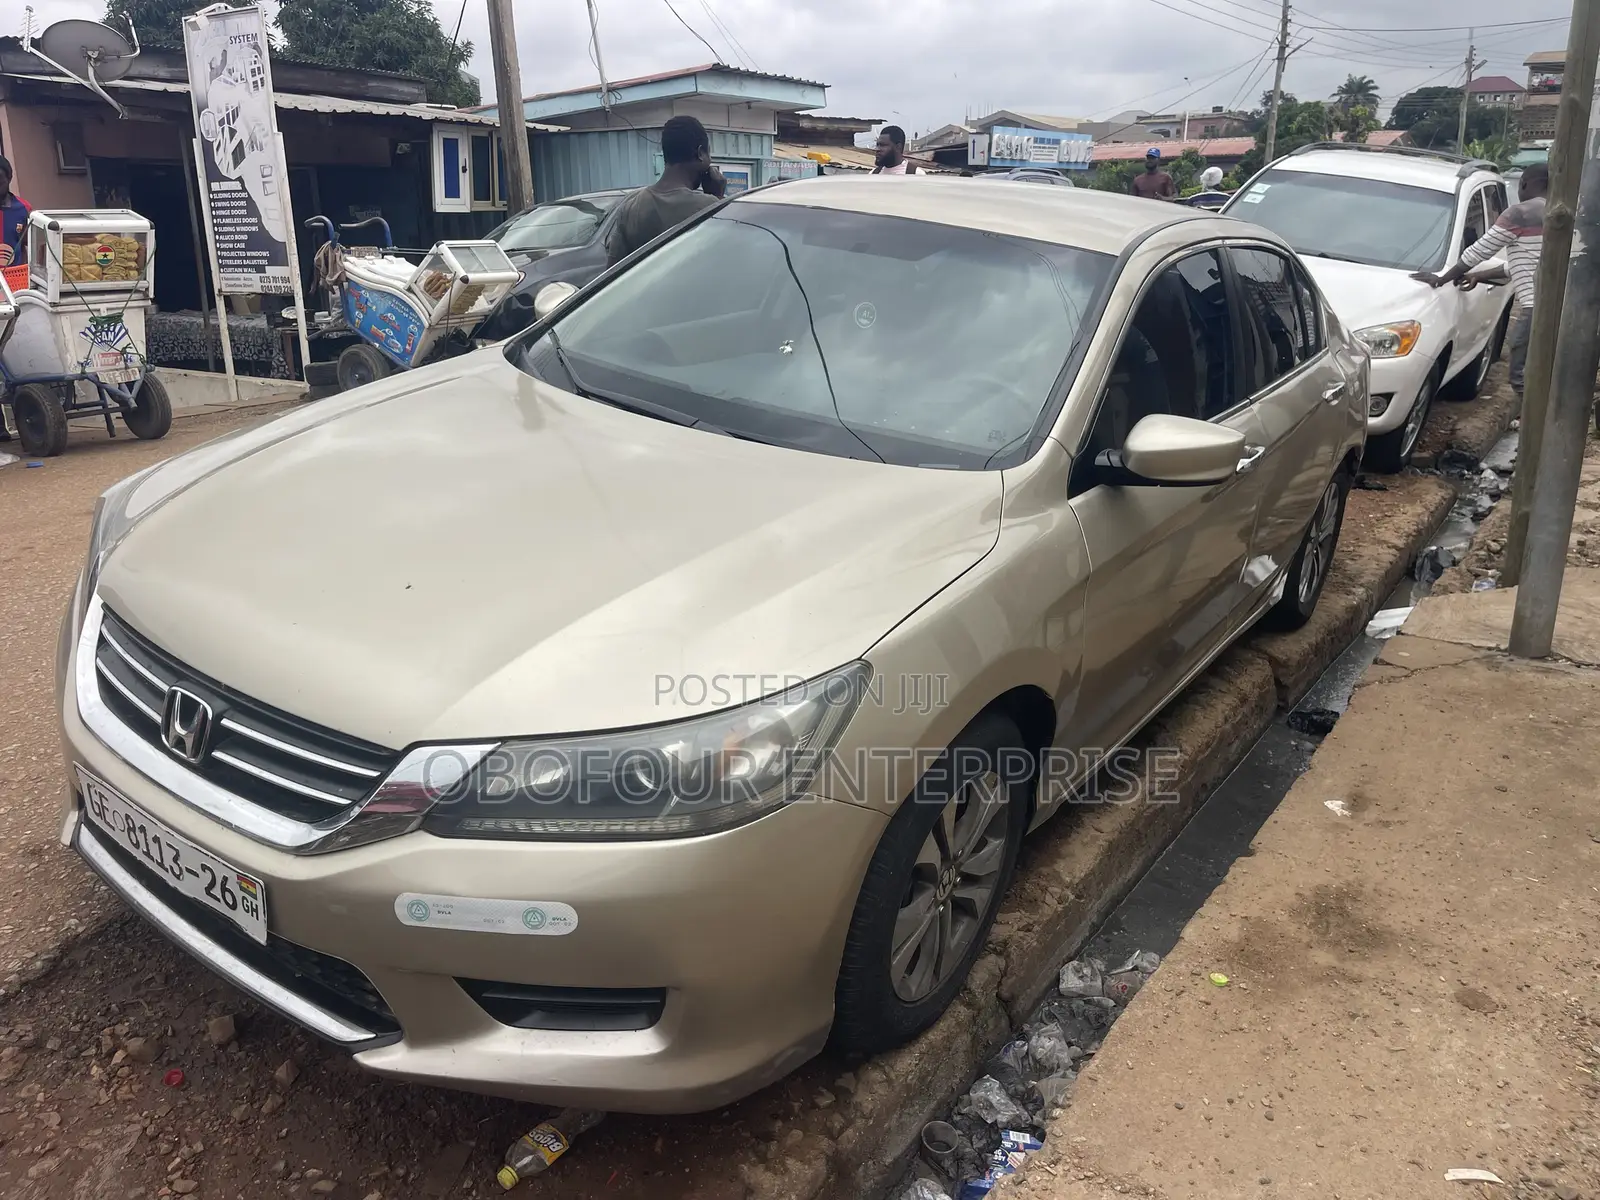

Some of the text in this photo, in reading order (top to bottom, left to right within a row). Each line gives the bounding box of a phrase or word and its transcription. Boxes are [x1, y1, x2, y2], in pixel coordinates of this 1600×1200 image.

[229, 33, 258, 44] SYSTEM
[86, 782, 237, 911] GE 8113-26
[241, 896, 259, 920] GH
